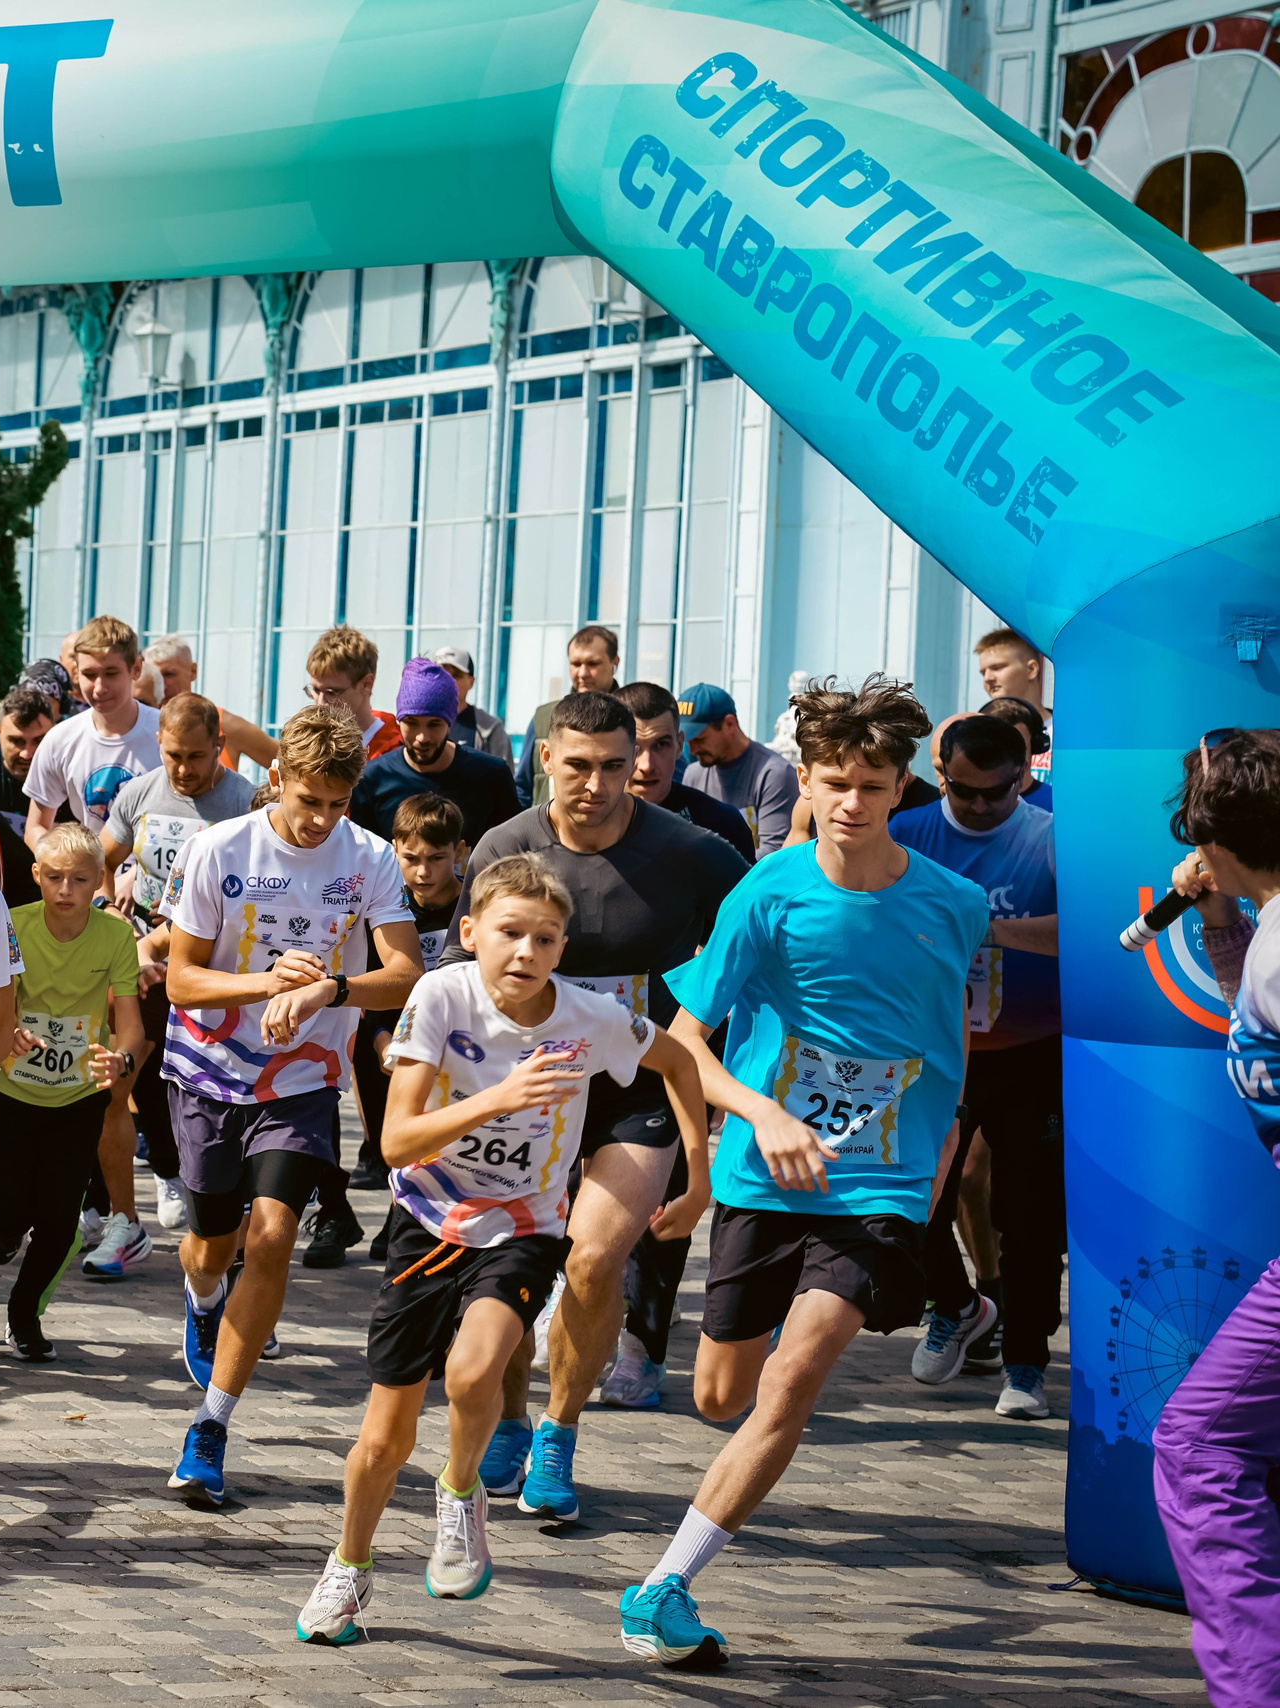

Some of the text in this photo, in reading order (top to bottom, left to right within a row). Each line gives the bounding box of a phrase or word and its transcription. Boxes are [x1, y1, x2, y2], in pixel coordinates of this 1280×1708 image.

[675, 51, 1186, 449] СПОРТИВНОЕ
[619, 134, 1079, 547] СТАВРОПОЛЬЕ
[246, 876, 291, 889] СКФУ
[322, 895, 362, 905] TRIATHON
[27, 1044, 74, 1074] 260
[457, 1134, 532, 1172] 264
[853, 1145, 875, 1155] КРАЙ
